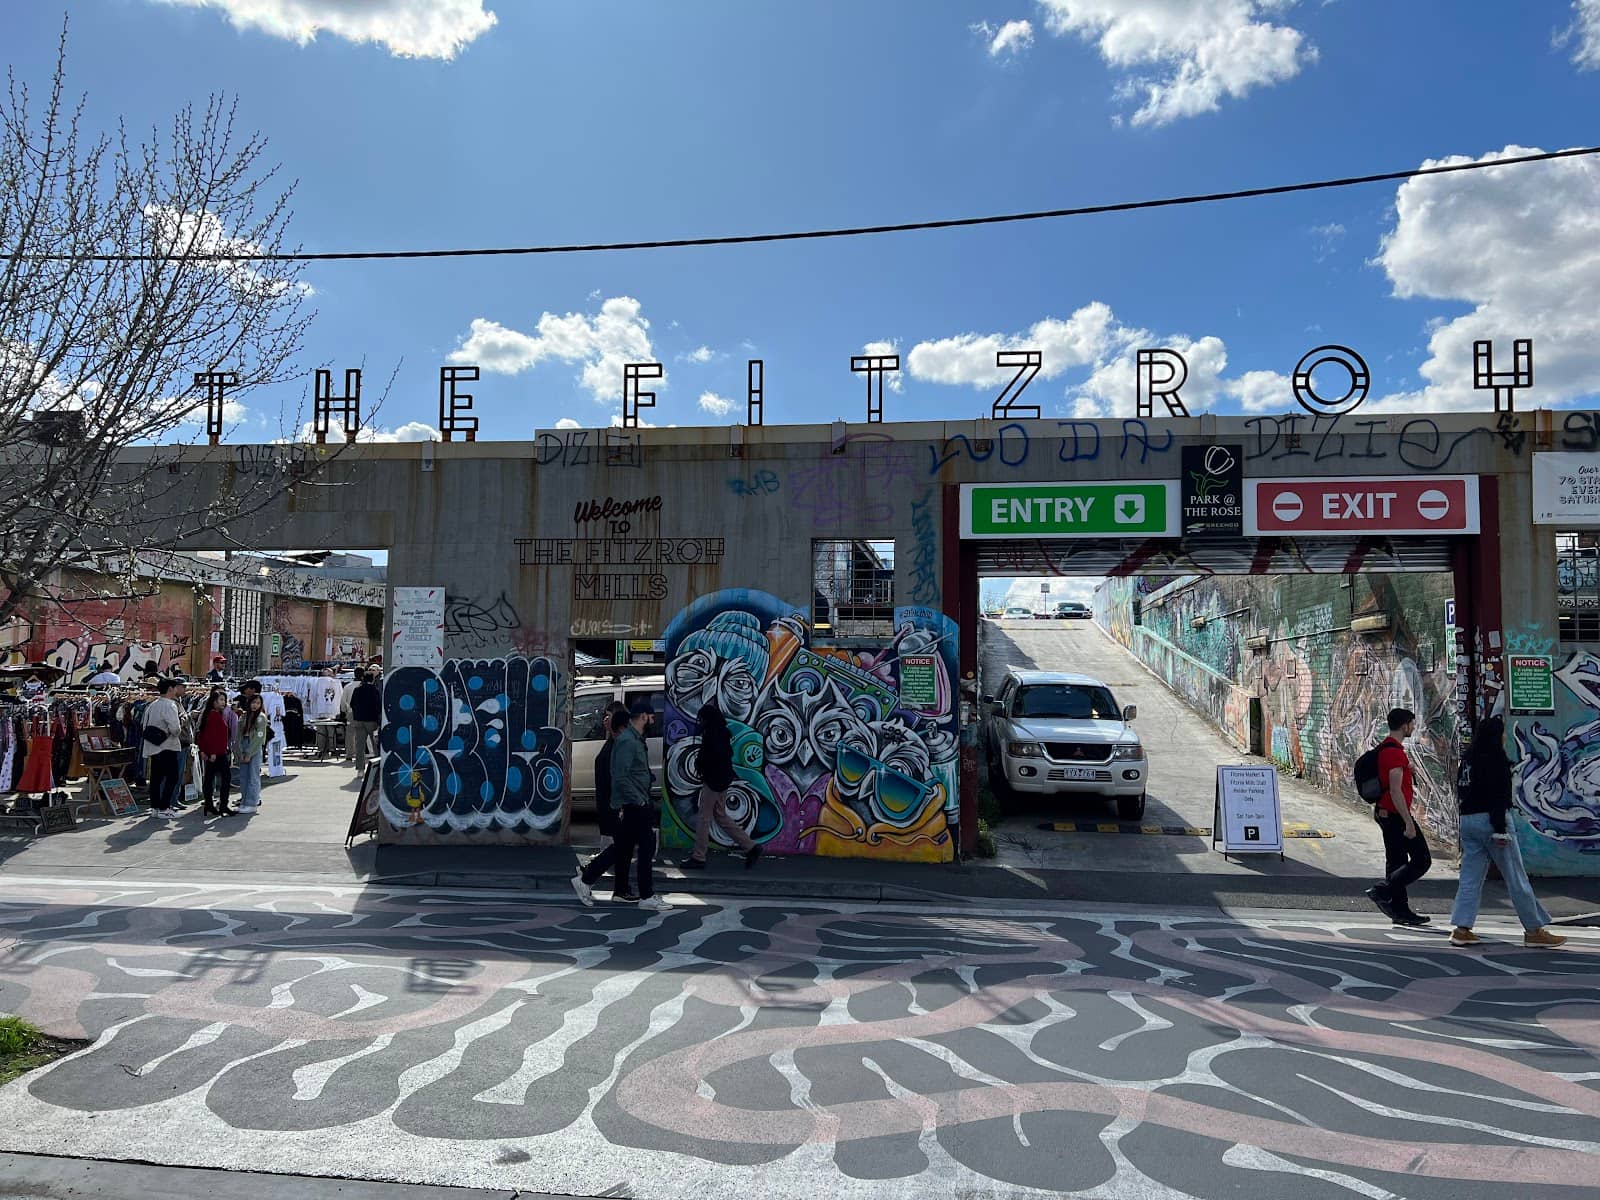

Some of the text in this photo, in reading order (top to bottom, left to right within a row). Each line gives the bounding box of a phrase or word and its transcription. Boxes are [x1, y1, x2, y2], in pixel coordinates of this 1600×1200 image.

[574, 495, 663, 523] Welcome
[991, 497, 1095, 525] ENTRY
[1184, 506, 1241, 517] THE ROSE
[1190, 493, 1235, 506] PARK @
[1322, 491, 1398, 521] EXIT
[609, 520, 631, 534] TO
[514, 538, 573, 565] THE
[575, 573, 668, 600] MILLS
[1247, 828, 1256, 839] P
